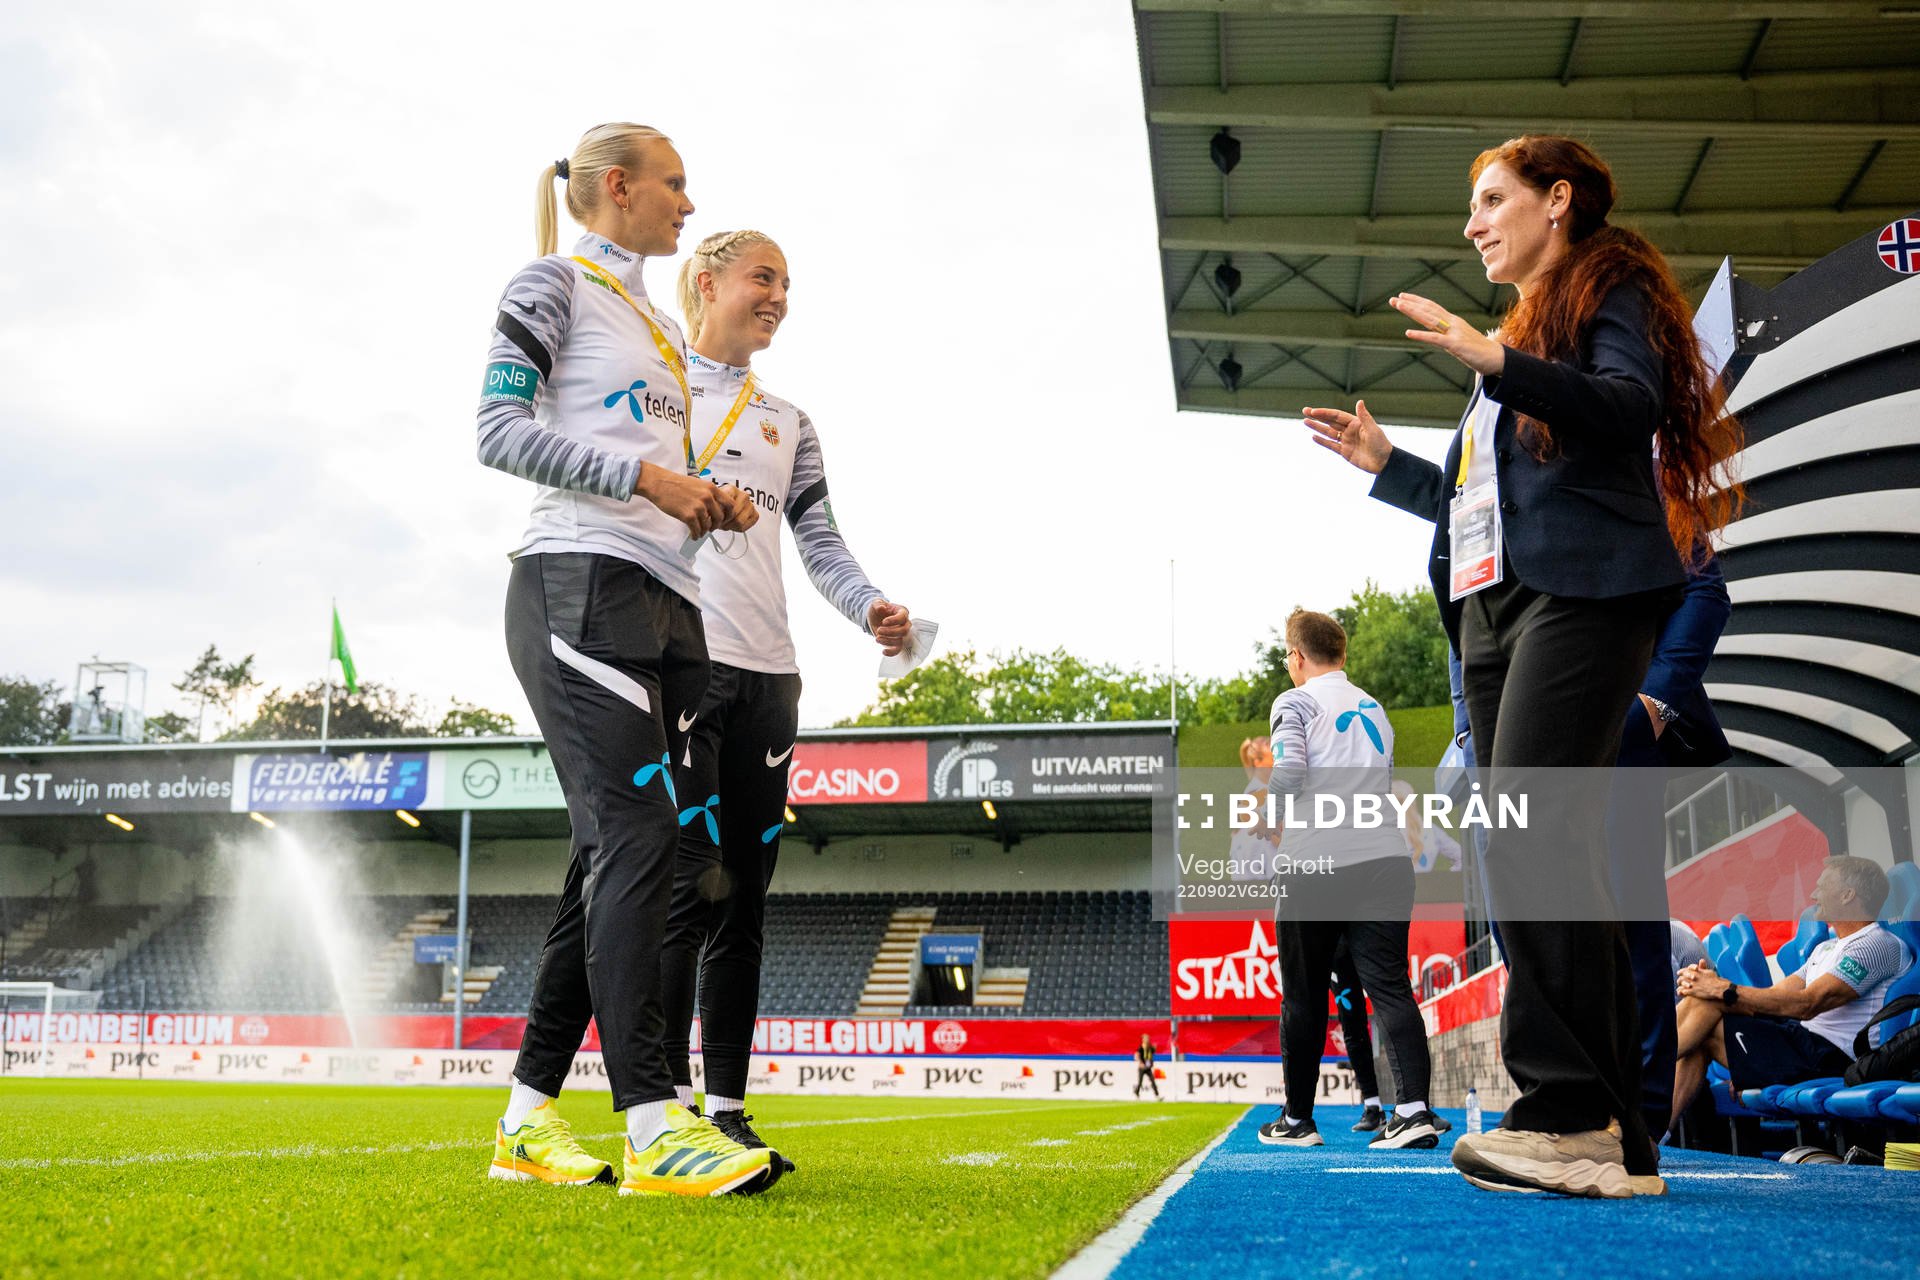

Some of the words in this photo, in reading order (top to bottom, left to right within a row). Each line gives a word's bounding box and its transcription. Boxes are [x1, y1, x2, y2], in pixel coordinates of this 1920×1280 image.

[609, 247, 632, 262] telenor
[697, 358, 717, 371] telenor
[489, 365, 527, 390] DNB
[253, 759, 394, 787] FEDERALE
[1031, 755, 1164, 777] UITVAARTEN
[0, 773, 52, 802] LST
[54, 778, 99, 806] wijn
[106, 779, 151, 800] met
[157, 775, 233, 800] advies
[791, 767, 900, 797] CASINO
[1099, 782, 1122, 793] voor
[251, 785, 388, 804] Verzekering
[110, 1051, 160, 1072] pwc
[217, 1053, 268, 1074] pwc
[440, 1058, 493, 1080] pwc
[797, 1064, 856, 1087] pwc
[872, 1078, 898, 1089] pwc
[924, 1066, 983, 1089] pwc
[1000, 1080, 1027, 1091] pwc
[1053, 1069, 1114, 1092] pwc
[1186, 1071, 1248, 1095] pwc
